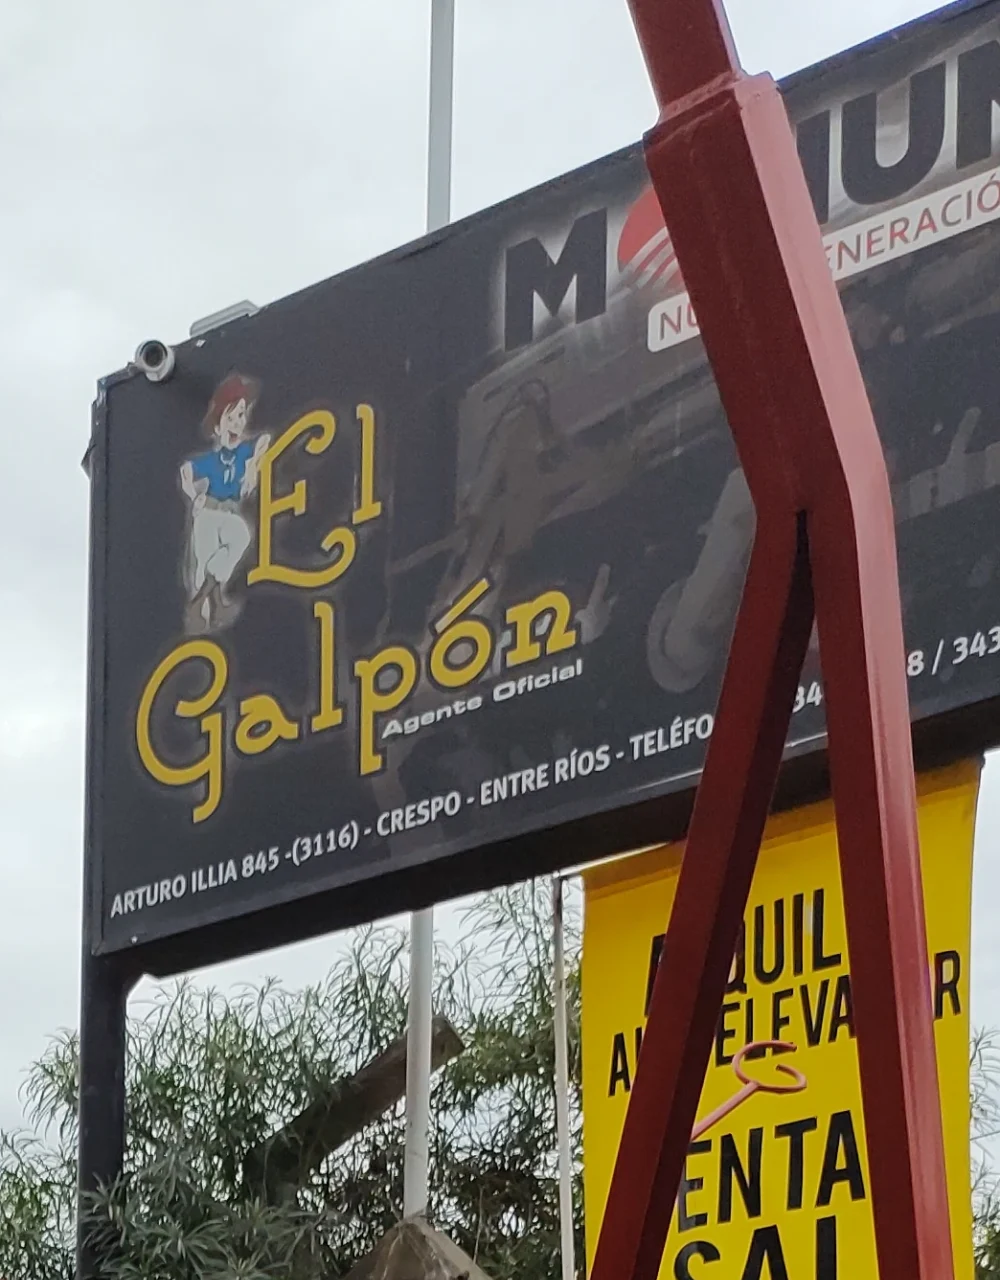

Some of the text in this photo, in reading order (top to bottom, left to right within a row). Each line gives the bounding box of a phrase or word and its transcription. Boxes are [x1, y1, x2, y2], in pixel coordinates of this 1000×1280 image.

[825, 173, 1000, 271] NERACIÓ
[247, 403, 381, 587] El
[136, 577, 576, 823] Galpón
[381, 659, 583, 739] Agente Oficial
[110, 875, 186, 918] ARTURO
[191, 859, 238, 894] ILLIA
[241, 847, 279, 878] 845
[376, 791, 461, 837] CRESPO
[480, 763, 549, 806] ENTRE
[555, 745, 611, 785] RÍOS
[630, 713, 715, 761] TELÉFO
[677, 1110, 866, 1233] ENTA
